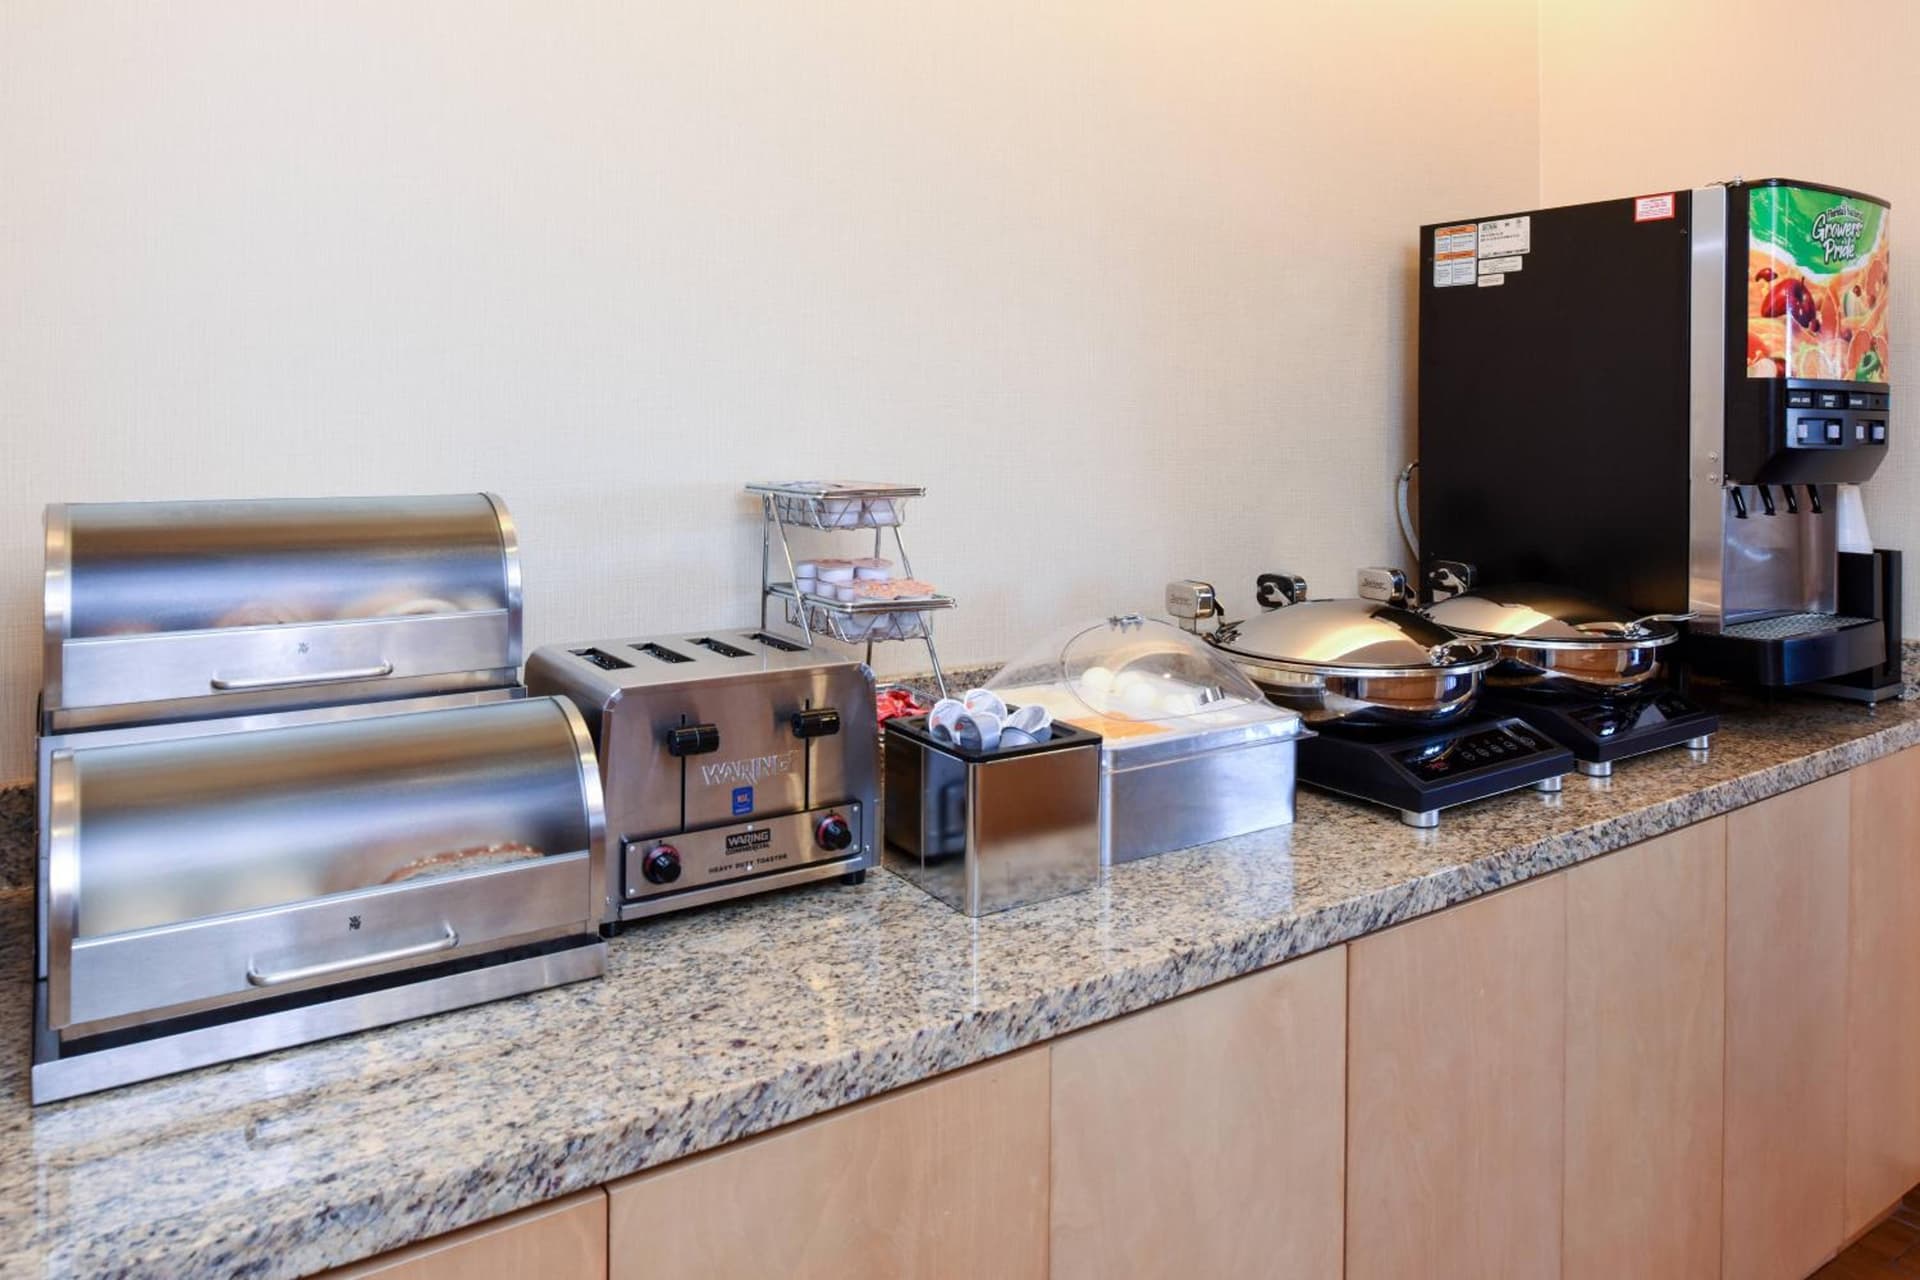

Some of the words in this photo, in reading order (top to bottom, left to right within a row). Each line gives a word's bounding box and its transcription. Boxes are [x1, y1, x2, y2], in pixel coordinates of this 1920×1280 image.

[1823, 237, 1855, 263] Pride
[727, 830, 770, 848] WARING
[756, 853, 788, 864] TOASTER
